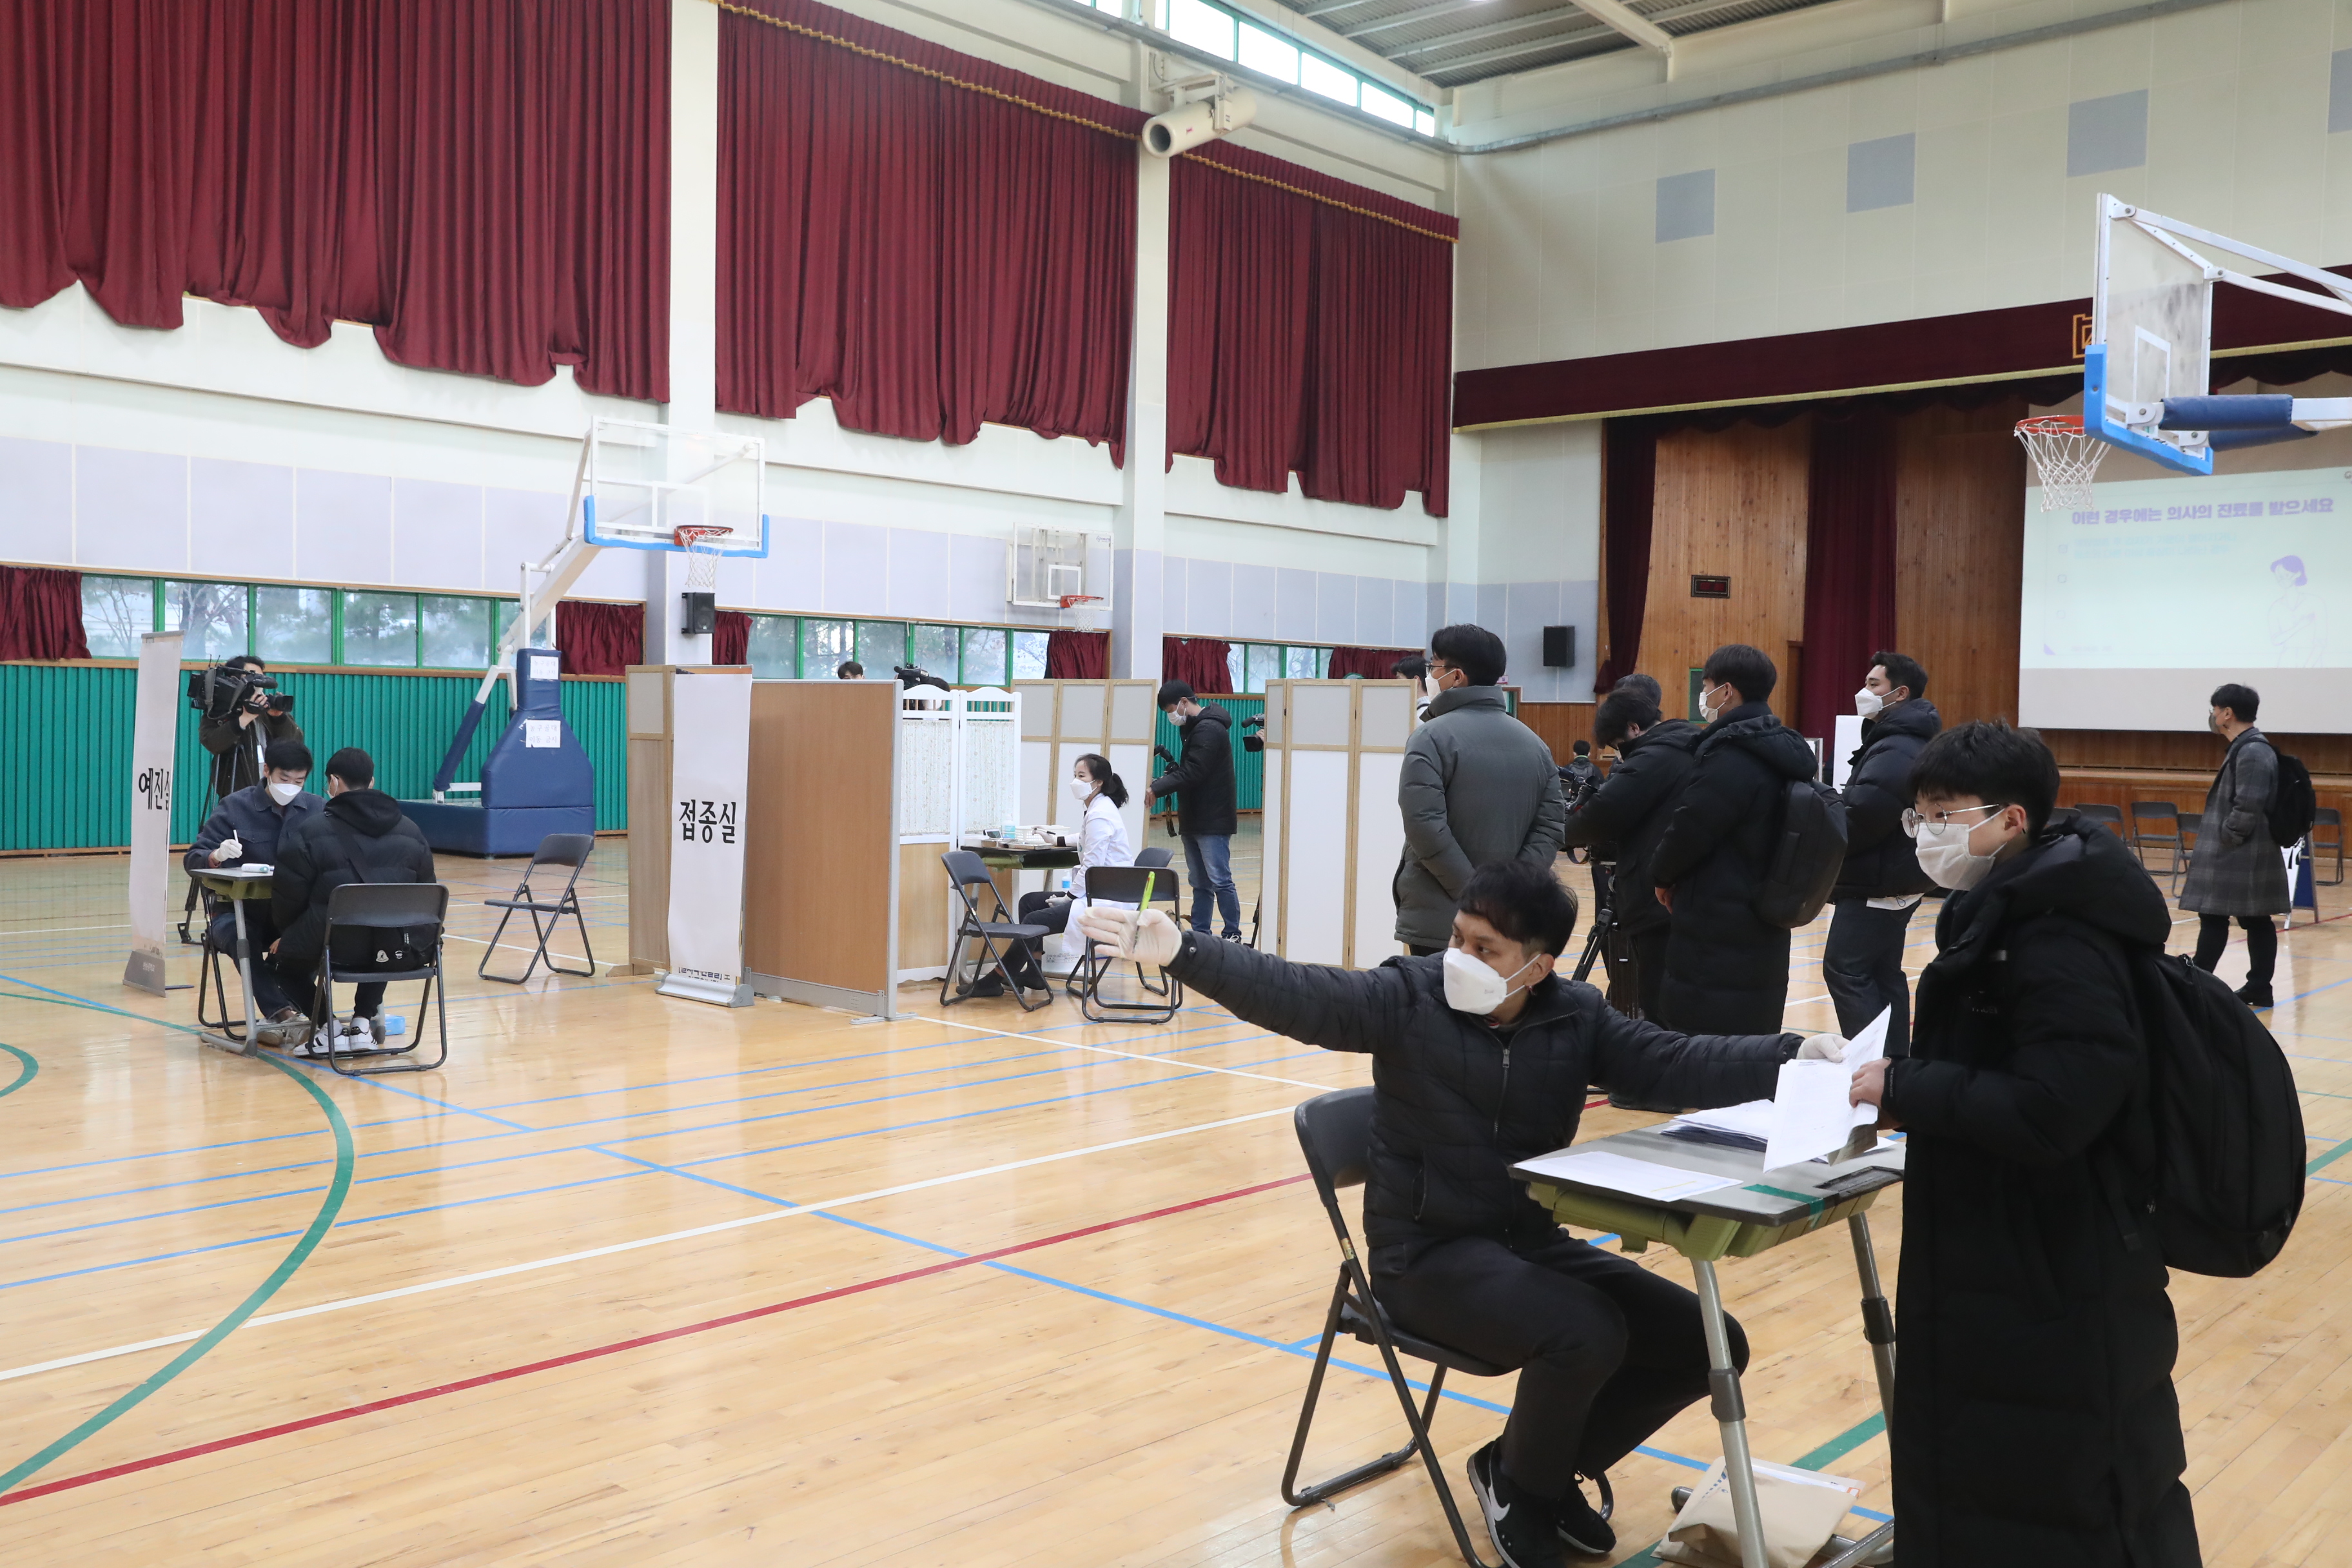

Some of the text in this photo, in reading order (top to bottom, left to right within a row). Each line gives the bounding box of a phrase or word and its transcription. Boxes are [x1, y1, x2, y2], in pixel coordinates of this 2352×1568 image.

[2072, 511, 2100, 525] 이런
[2104, 508, 2162, 524] 경우에는
[2167, 504, 2212, 520] 의사의
[678, 799, 736, 844] 접종실
